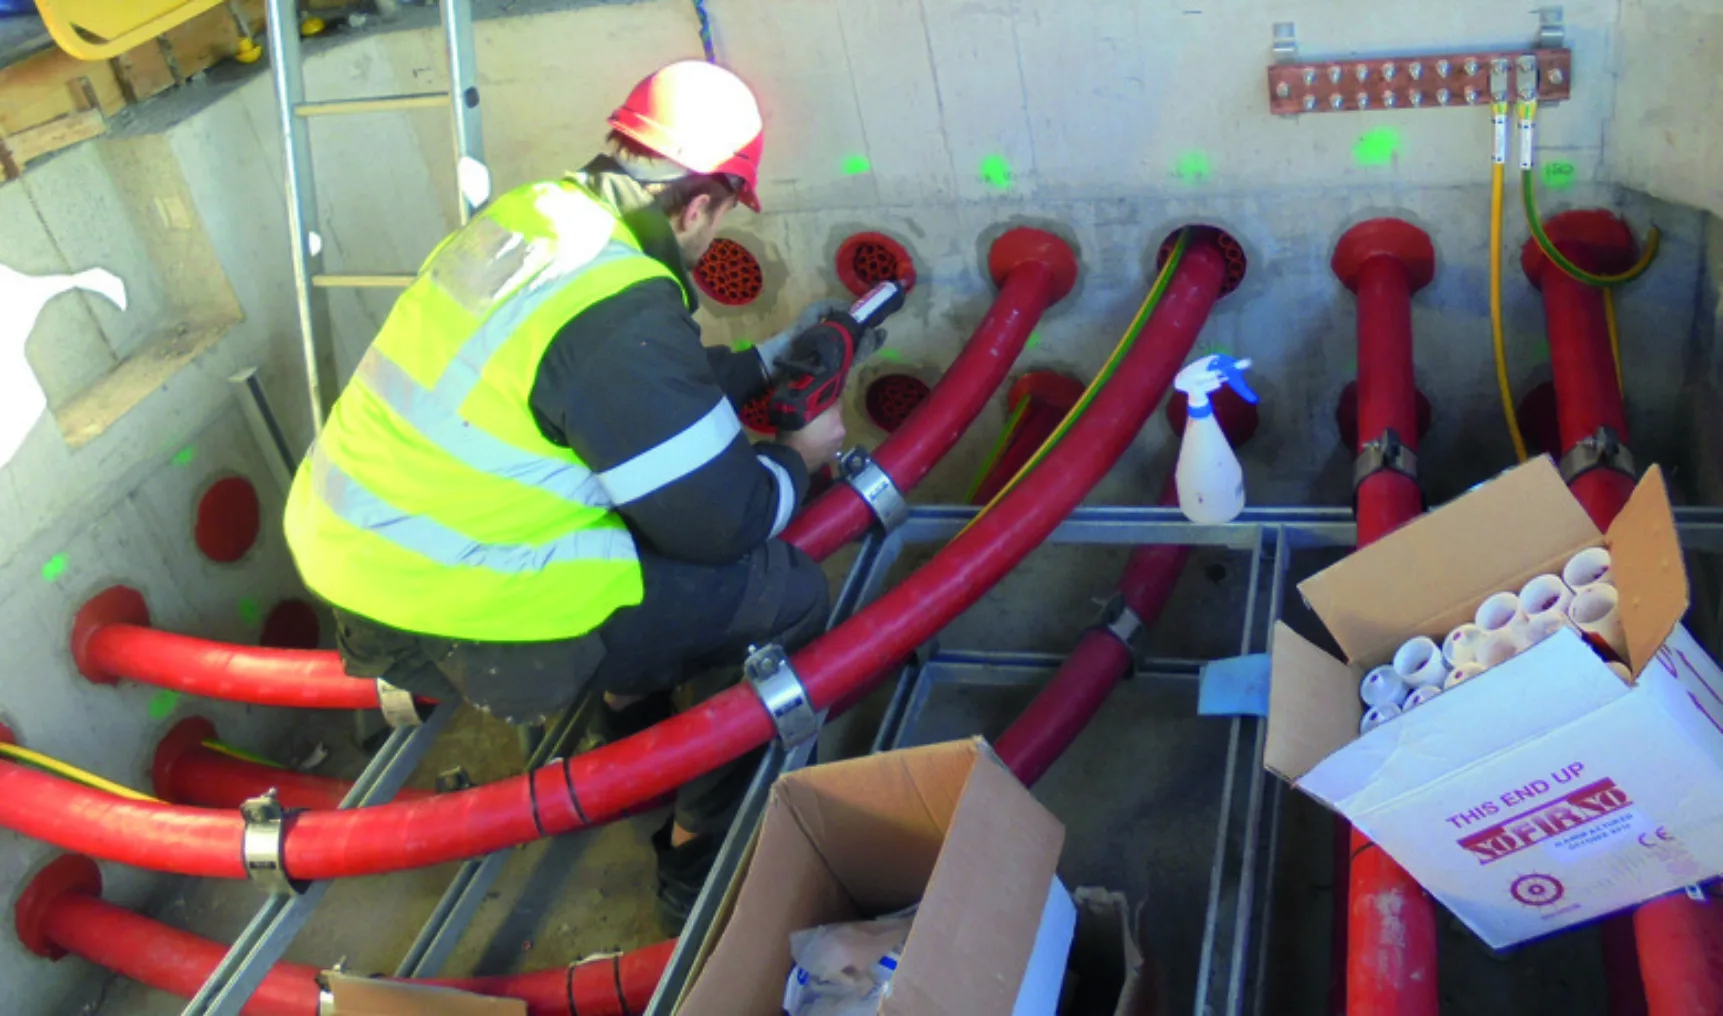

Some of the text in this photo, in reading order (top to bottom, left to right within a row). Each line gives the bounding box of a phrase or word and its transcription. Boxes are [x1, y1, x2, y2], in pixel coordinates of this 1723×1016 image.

[1446, 761, 1584, 829] THIS END UP
